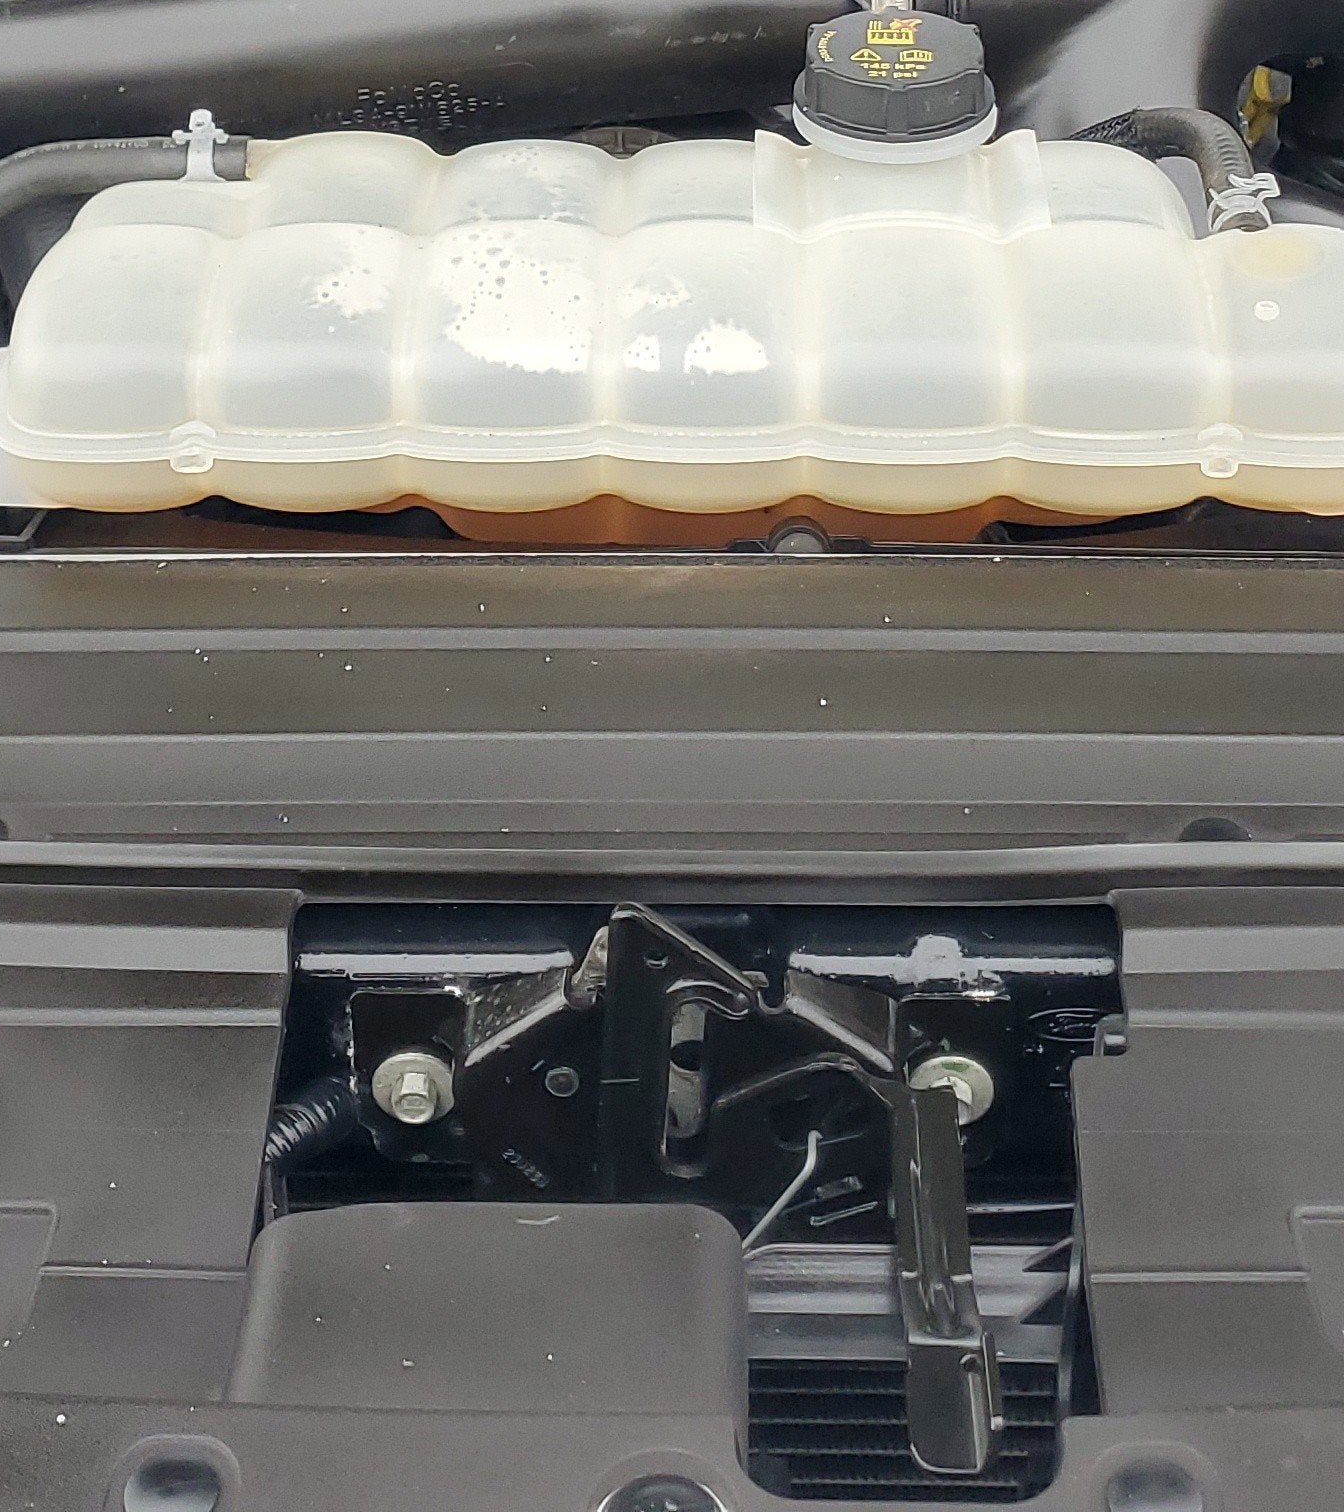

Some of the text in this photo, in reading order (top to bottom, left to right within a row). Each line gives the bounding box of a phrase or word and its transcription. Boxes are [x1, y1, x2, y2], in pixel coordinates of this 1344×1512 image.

[861, 62, 927, 70] 145 kPa
[893, 70, 918, 78] psi
